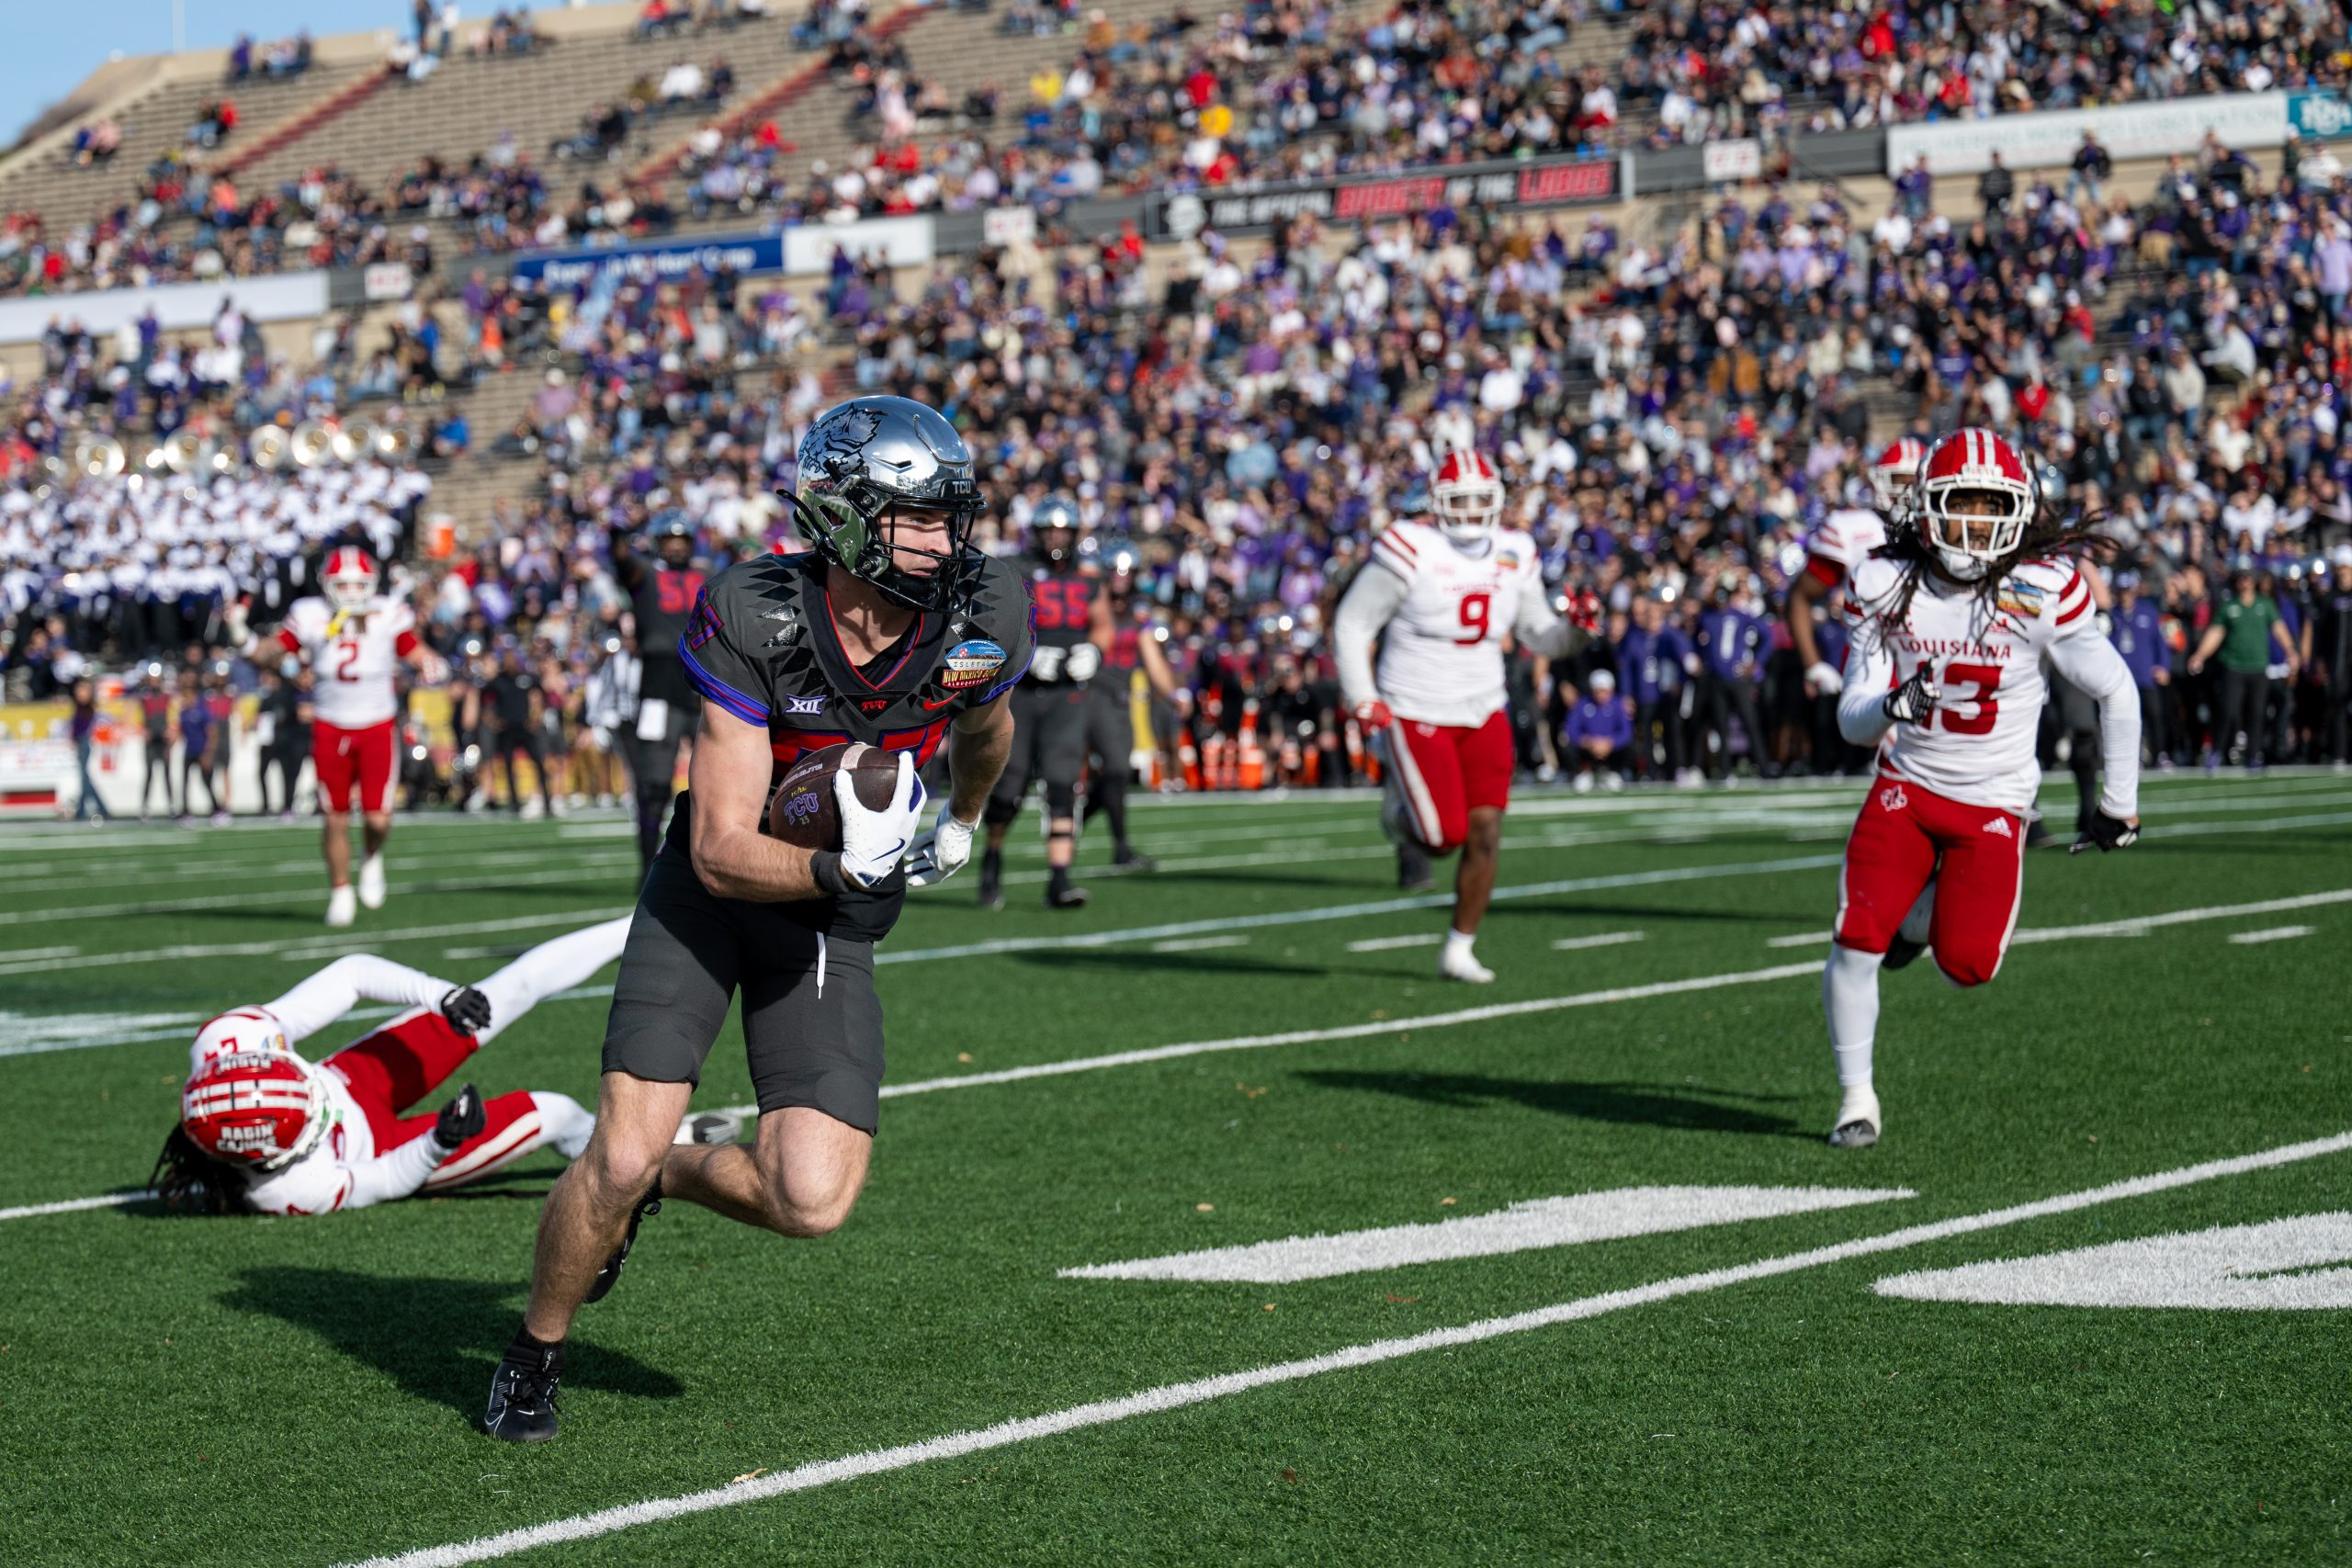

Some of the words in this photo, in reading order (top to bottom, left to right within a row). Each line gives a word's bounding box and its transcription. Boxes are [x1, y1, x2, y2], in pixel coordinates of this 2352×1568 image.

[1518, 160, 1614, 204] LOBOS
[952, 480, 971, 494] TCU
[1034, 580, 1089, 628] 55
[1453, 592, 1490, 645] 9
[337, 640, 359, 682] 2
[1898, 637, 2012, 659] LOUISIANA
[943, 671, 959, 683] NEW
[959, 669, 983, 681] MEXICO
[784, 694, 827, 716] XII
[862, 700, 888, 713] TCU
[784, 793, 819, 825] TCU
